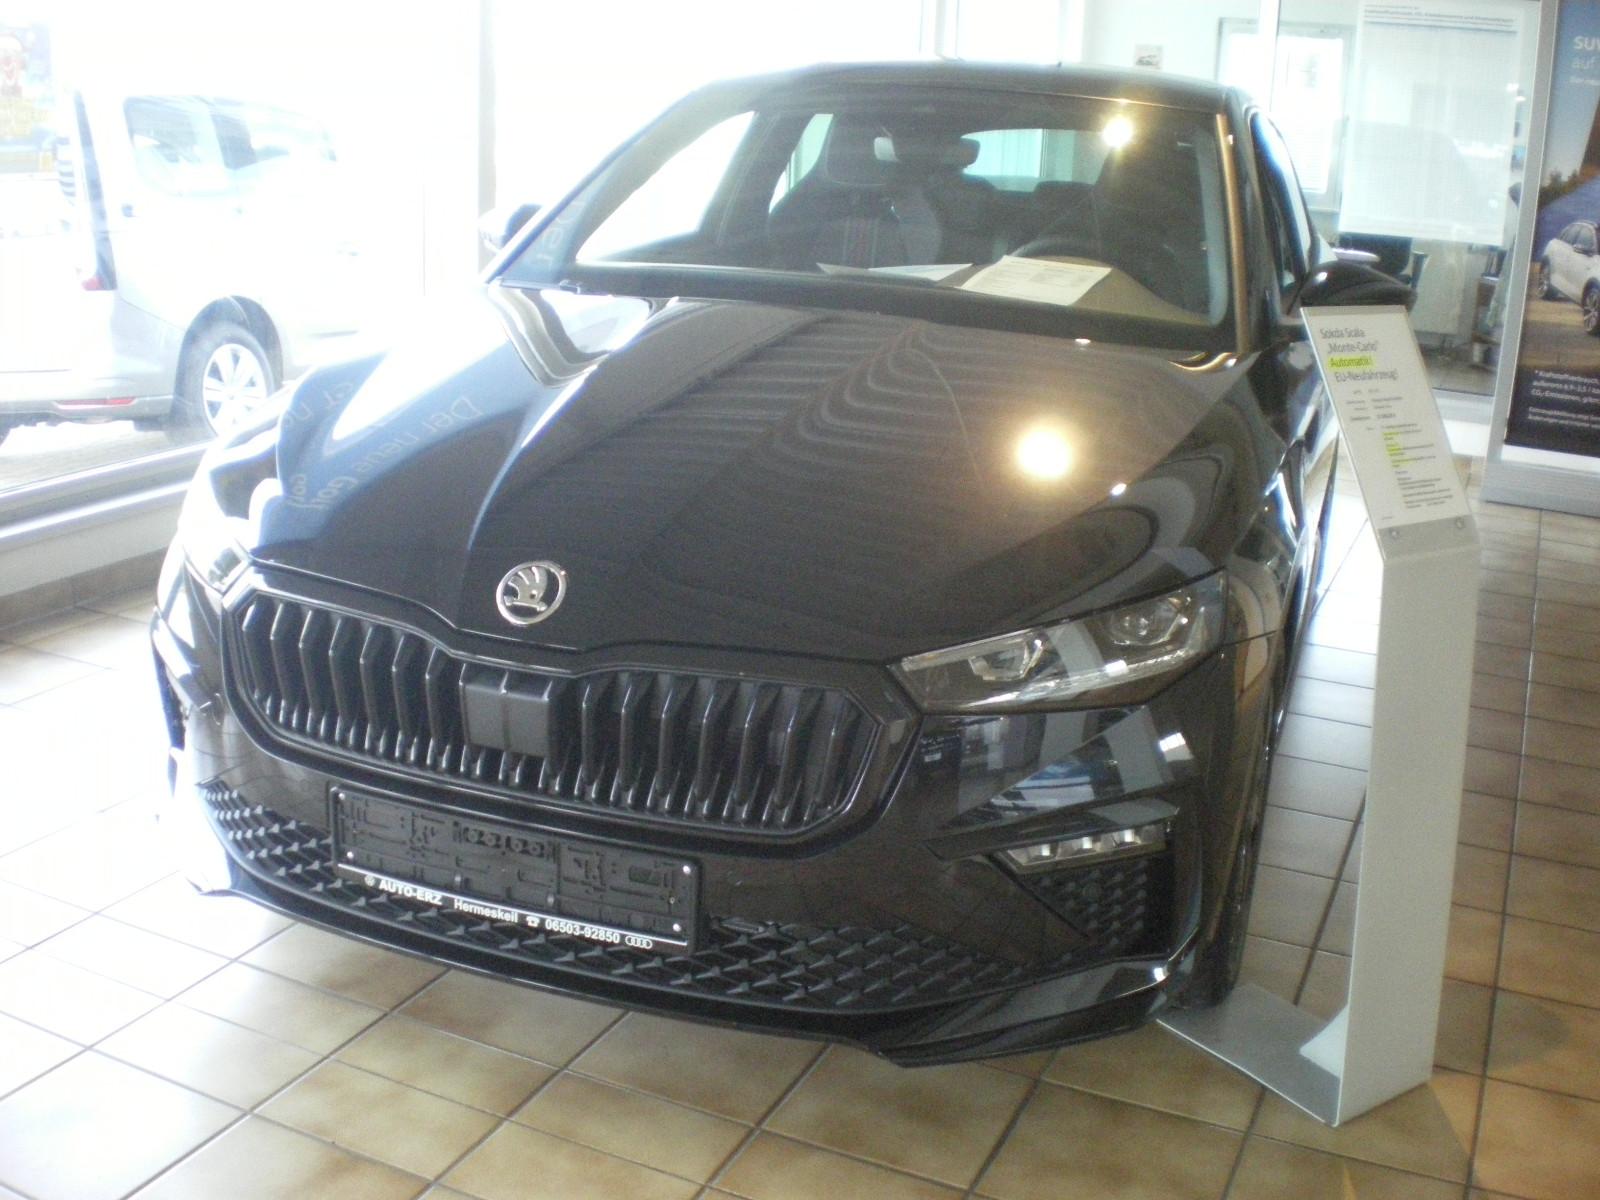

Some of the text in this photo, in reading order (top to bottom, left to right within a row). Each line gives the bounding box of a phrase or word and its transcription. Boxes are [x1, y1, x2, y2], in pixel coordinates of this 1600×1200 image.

[378, 878, 621, 944] AUTO-ERZ Hermeskeil 06503-92850
